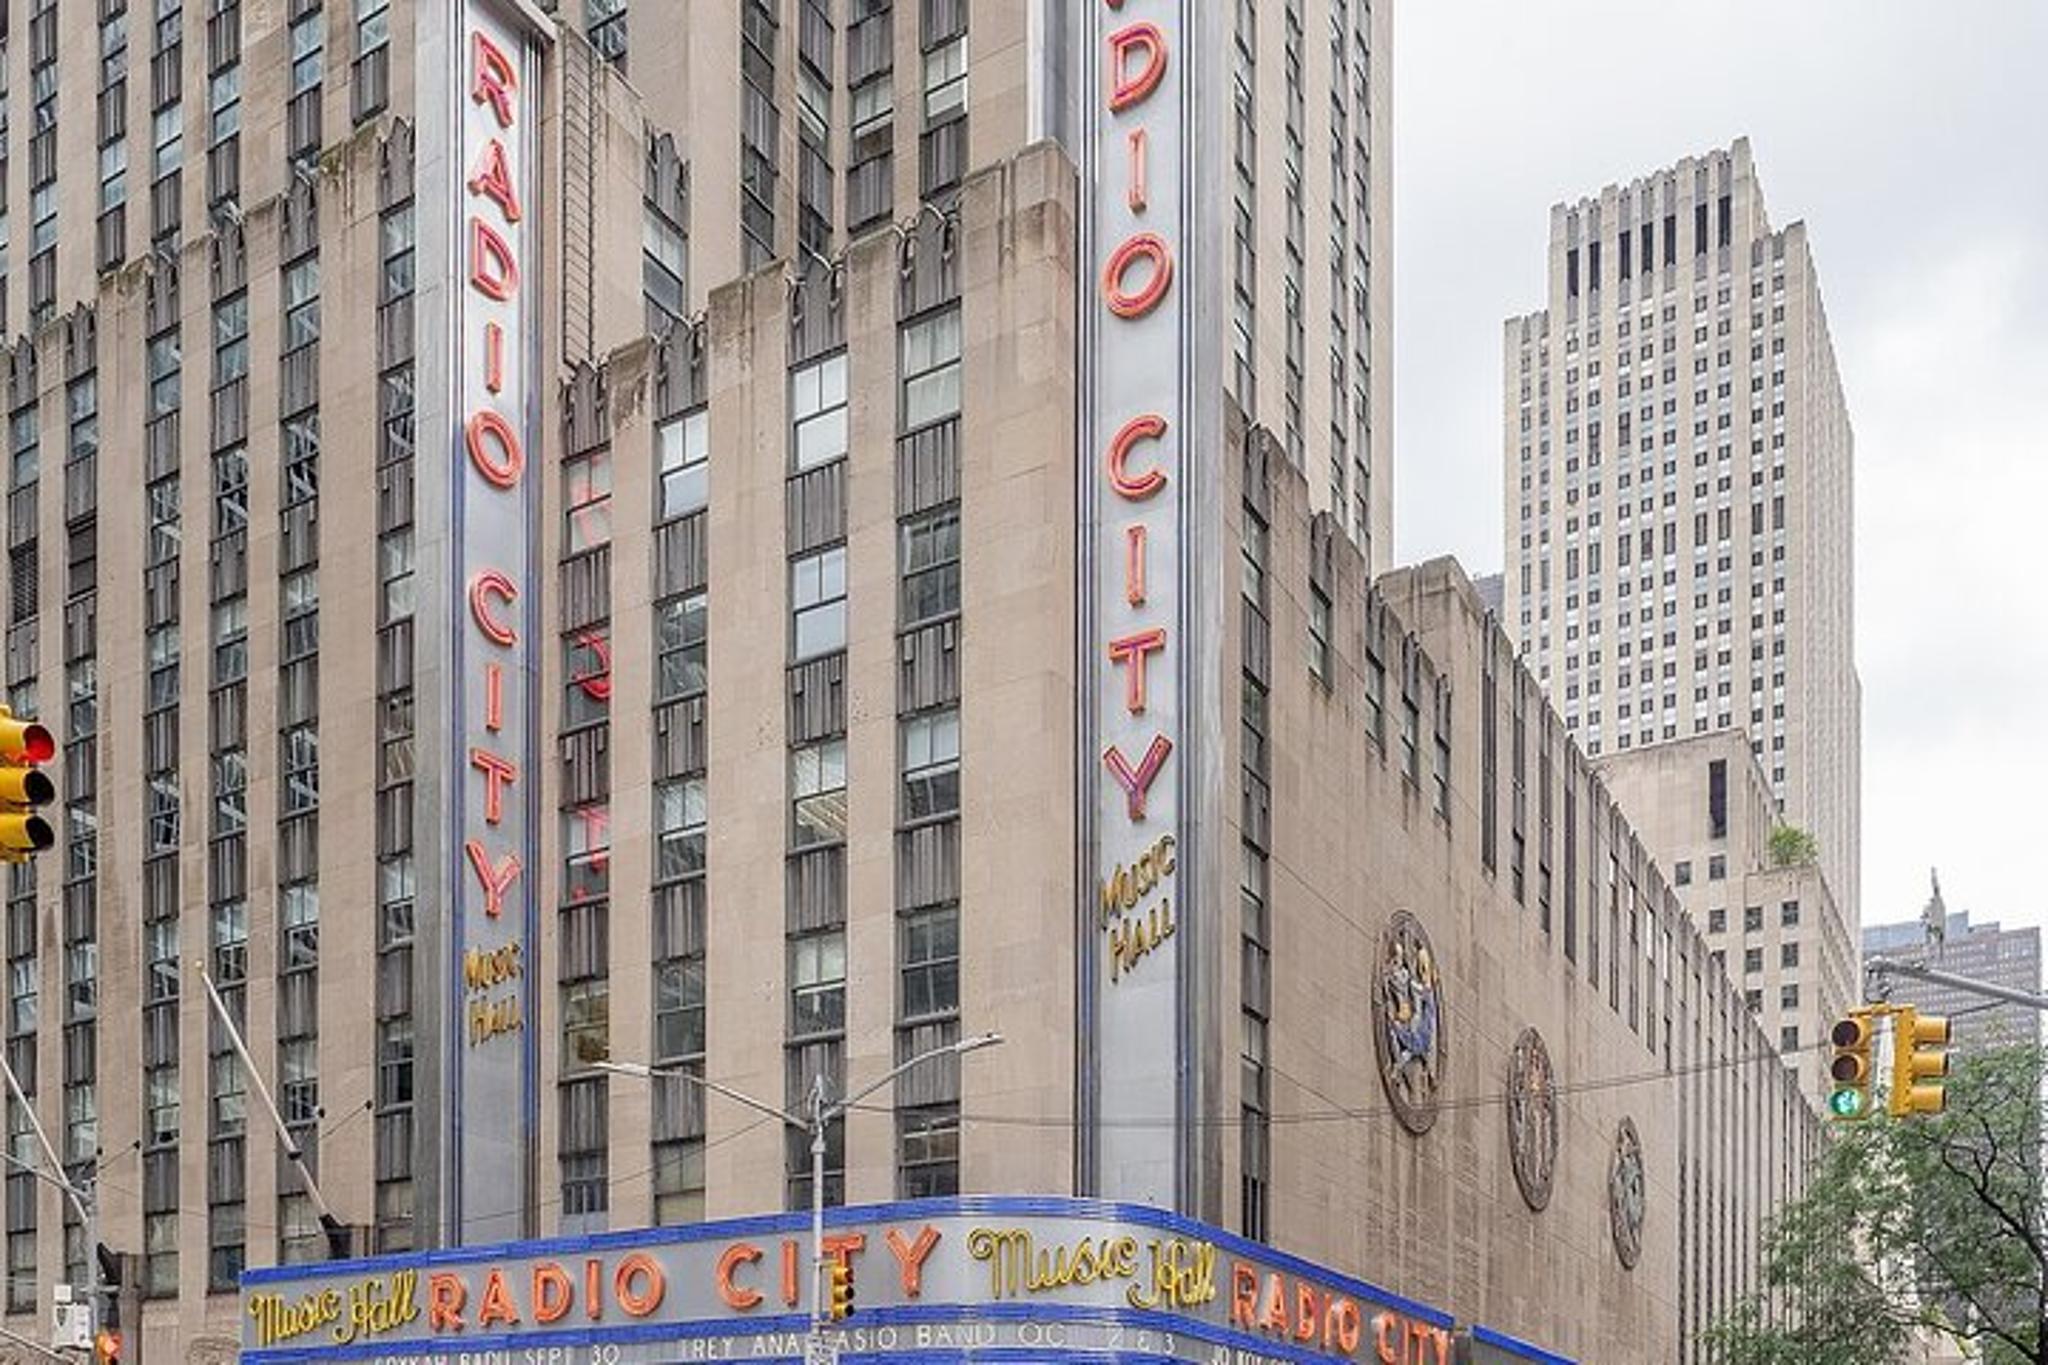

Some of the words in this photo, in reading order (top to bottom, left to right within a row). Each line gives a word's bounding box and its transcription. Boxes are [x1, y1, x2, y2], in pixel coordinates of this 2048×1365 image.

[467, 30, 524, 490] RADIO
[1102, 0, 1173, 319] DIO
[1102, 413, 1173, 823] CITY
[466, 568, 522, 919] CITY
[250, 1286, 342, 1347] Music
[333, 1268, 420, 1344] Hall
[428, 1252, 665, 1333] RADIO
[967, 1228, 1139, 1300] Music
[1126, 1237, 1216, 1309] Hall
[592, 1344, 620, 1365] 30
[752, 1327, 897, 1356] ANAASIO
[915, 1323, 996, 1347] BAND
[1231, 1260, 1360, 1354] RADIO
[1373, 1310, 1453, 1365] CITY
